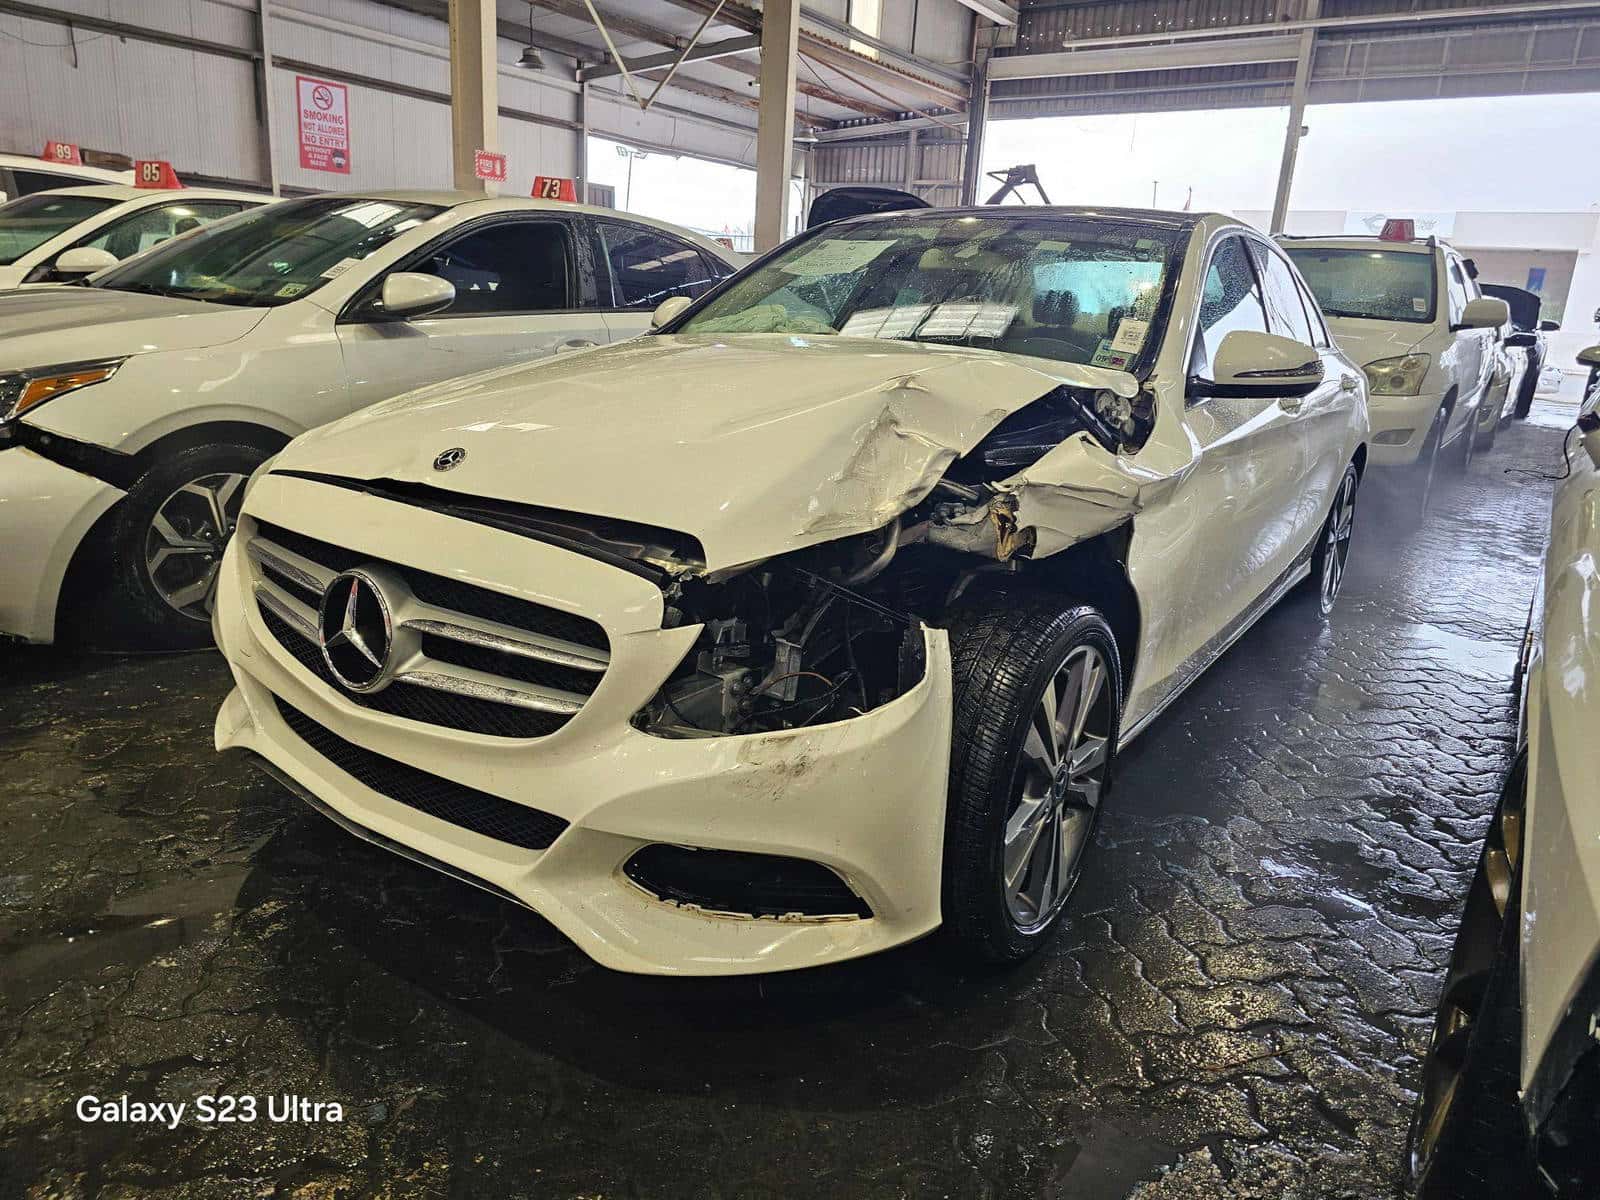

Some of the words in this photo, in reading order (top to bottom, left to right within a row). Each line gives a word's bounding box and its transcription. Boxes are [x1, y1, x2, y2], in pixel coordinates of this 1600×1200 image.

[303, 109, 344, 125] SMOKING
[303, 121, 317, 131] NOT
[318, 123, 345, 136] ALLOWED
[304, 134, 317, 144] NO
[319, 136, 345, 147] ENTRY
[56, 143, 72, 159] 89
[304, 146, 331, 155] WITHOUT
[143, 163, 160, 182] 85
[542, 178, 561, 198] 73
